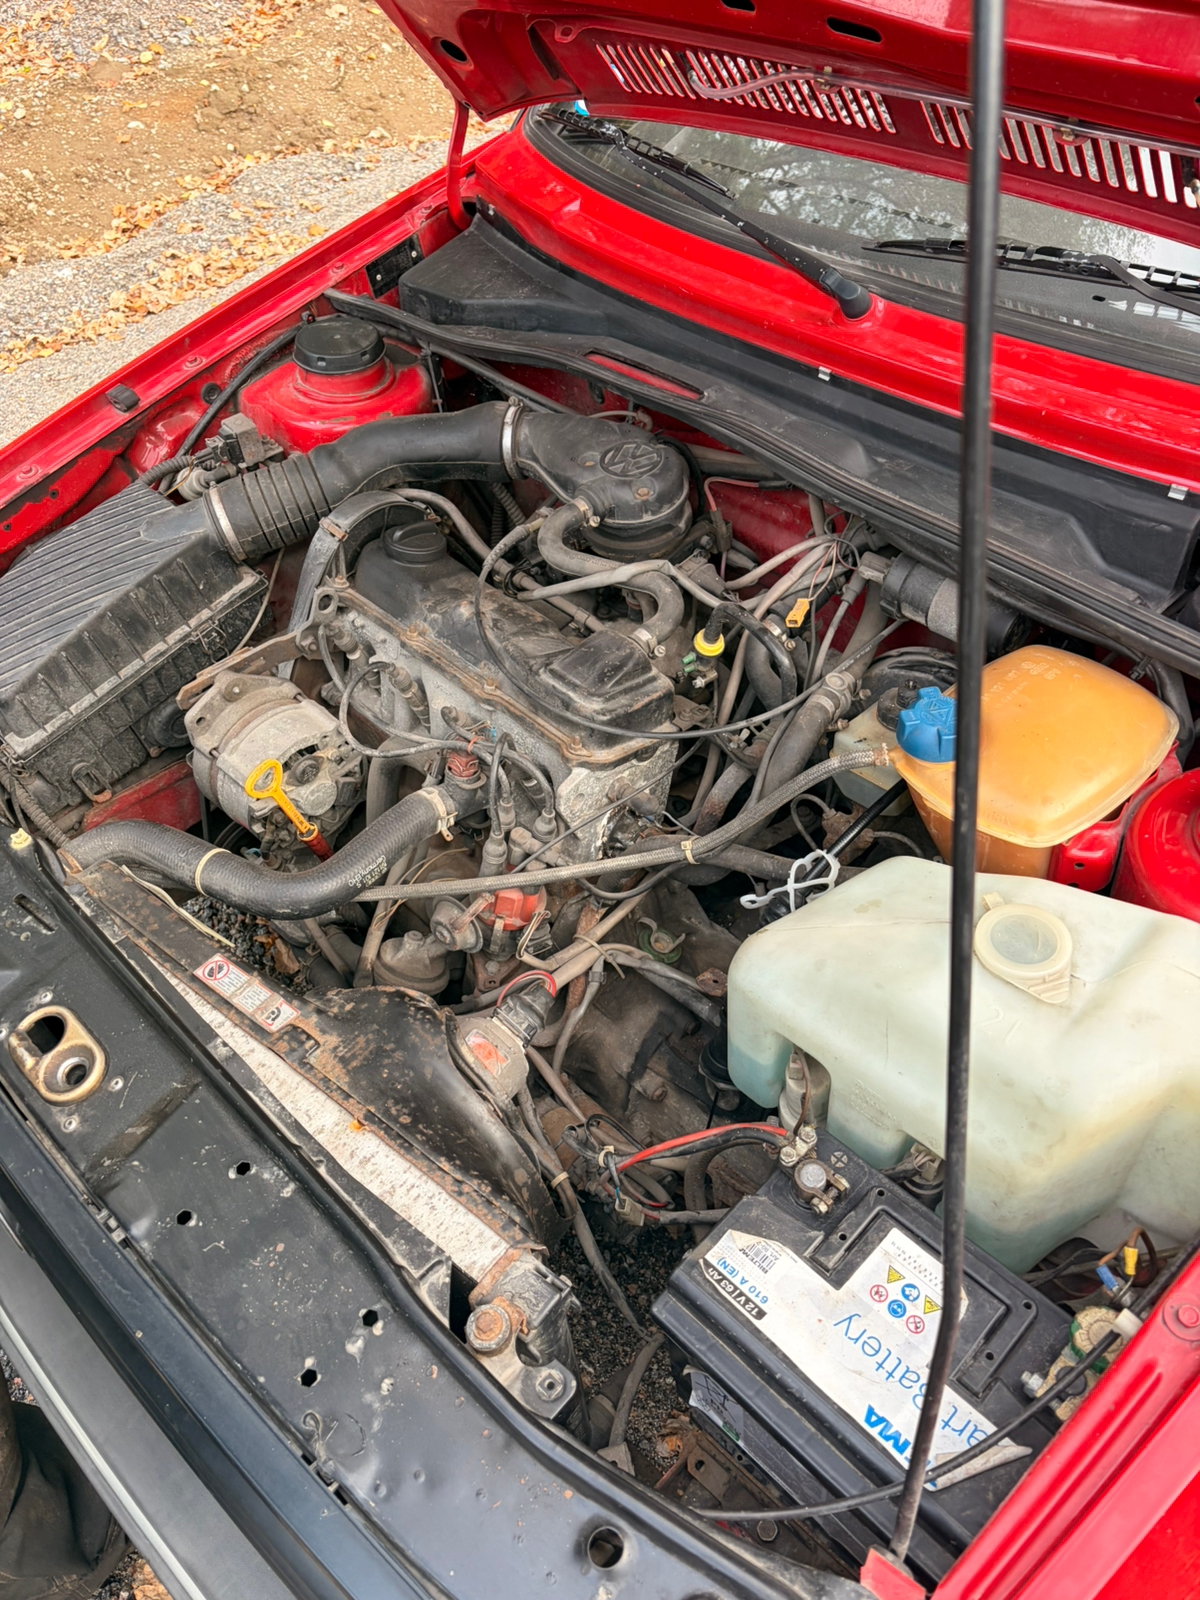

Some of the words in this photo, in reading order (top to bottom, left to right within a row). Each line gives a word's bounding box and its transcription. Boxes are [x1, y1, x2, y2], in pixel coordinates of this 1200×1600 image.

[708, 1267, 723, 1280] Ah
[716, 1256, 740, 1279] (EN)
[720, 1279, 734, 1292] 63
[739, 1275, 749, 1286] A
[737, 1295, 746, 1305] V
[748, 1285, 769, 1304] 610
[744, 1301, 759, 1316] 12
[941, 1405, 990, 1448] art
